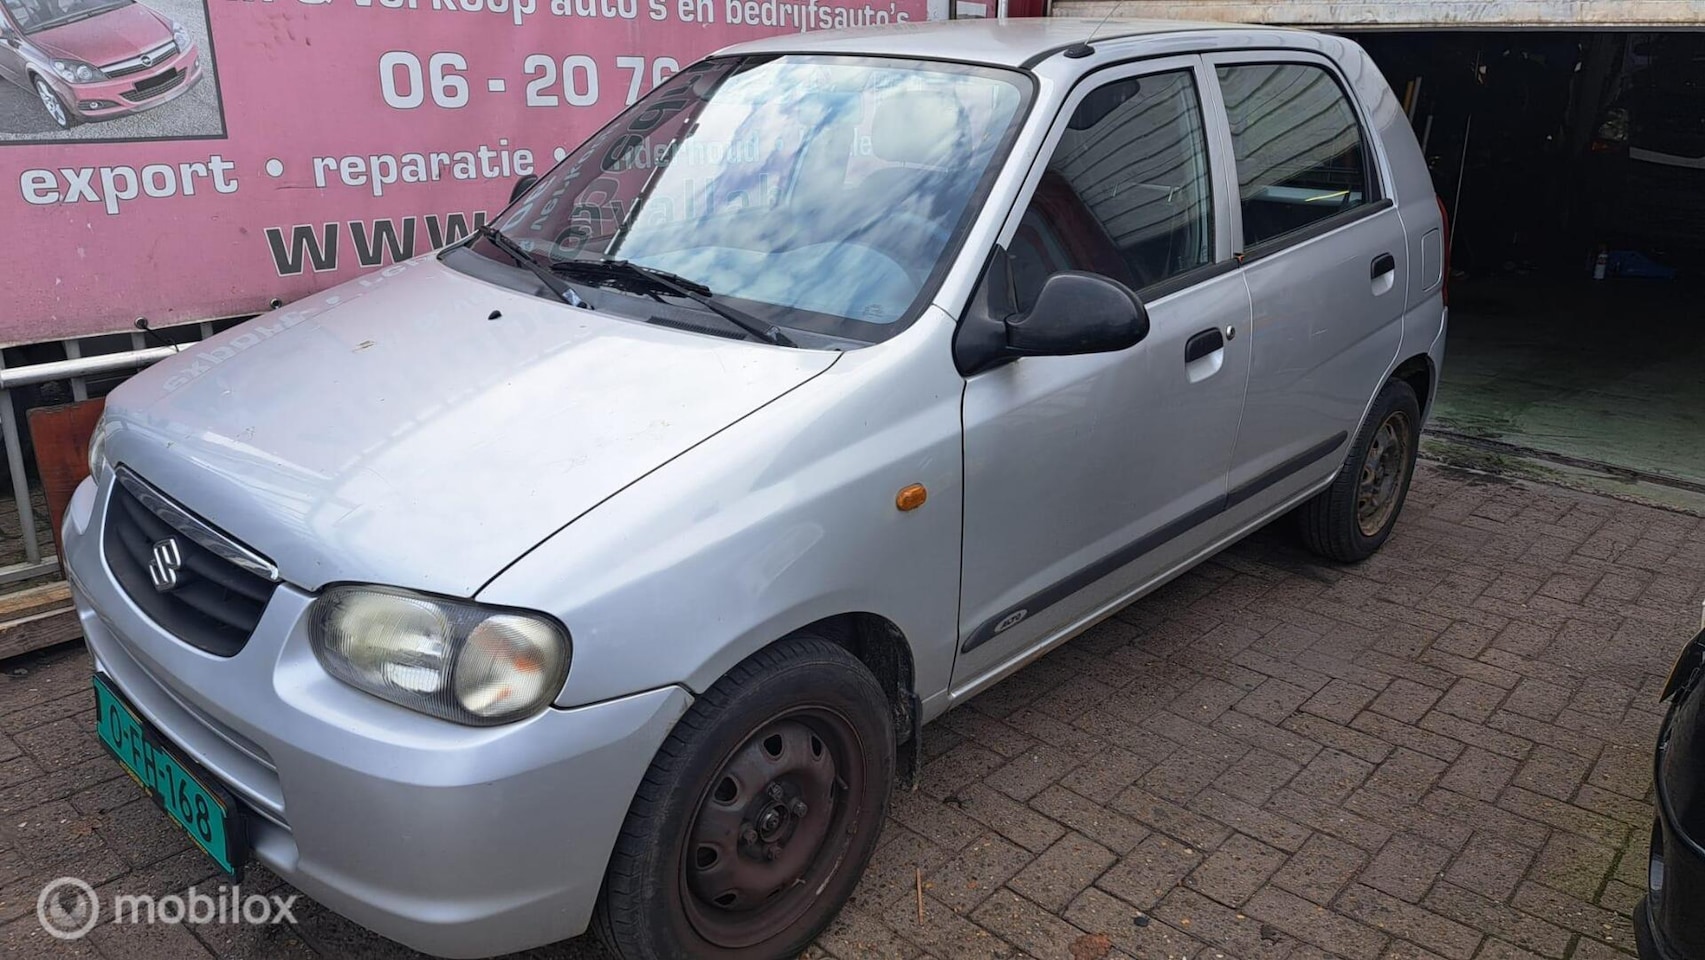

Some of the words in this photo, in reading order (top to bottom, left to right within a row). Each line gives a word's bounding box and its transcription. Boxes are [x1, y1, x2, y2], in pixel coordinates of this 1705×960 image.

[550, 0, 669, 20] autos
[677, 0, 714, 22] en
[378, 50, 470, 109] 06
[523, 54, 600, 108] 20
[19, 154, 240, 216] export
[312, 138, 535, 197] reparatie
